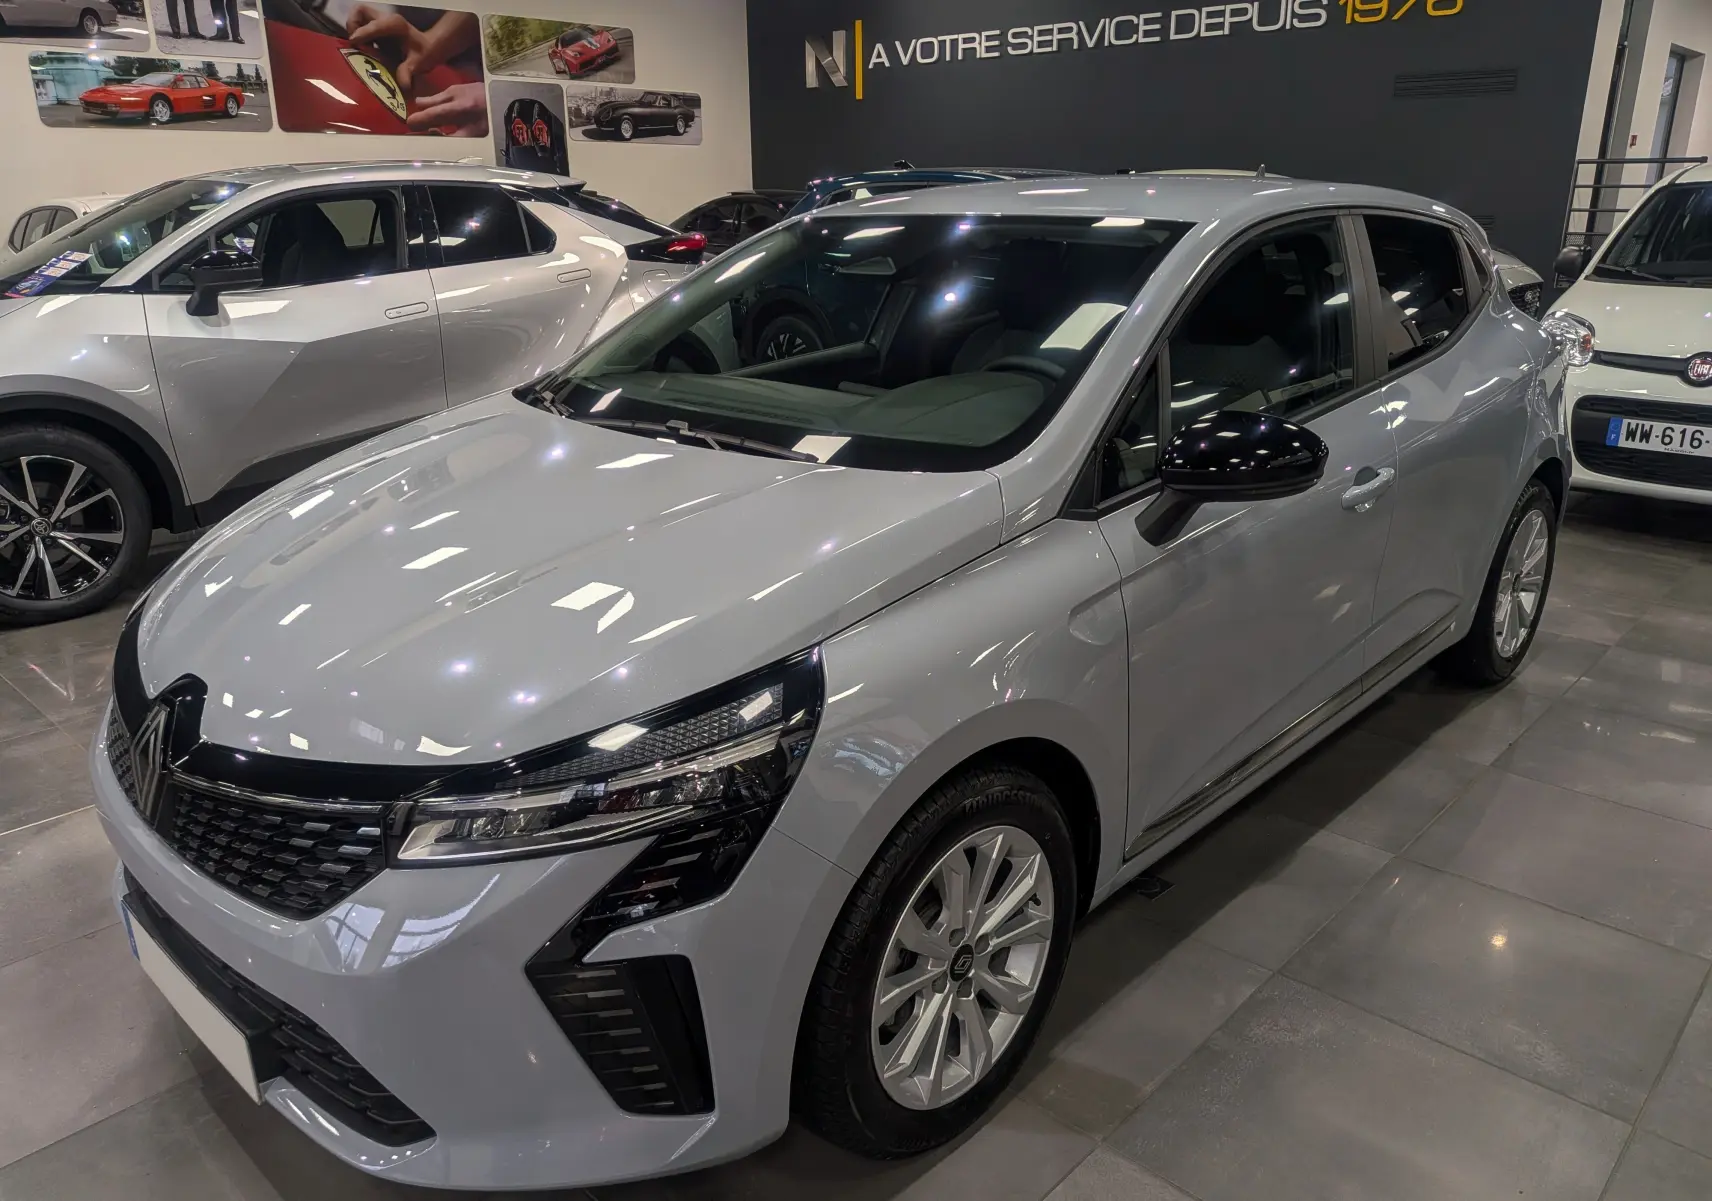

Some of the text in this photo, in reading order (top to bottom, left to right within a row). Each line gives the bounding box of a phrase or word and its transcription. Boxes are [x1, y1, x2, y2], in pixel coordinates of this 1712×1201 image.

[868, 43, 890, 69] A
[895, 30, 1001, 65] VOTRE
[1007, 12, 1163, 55] SERVICE
[1169, 0, 1328, 40] DEPUIS
